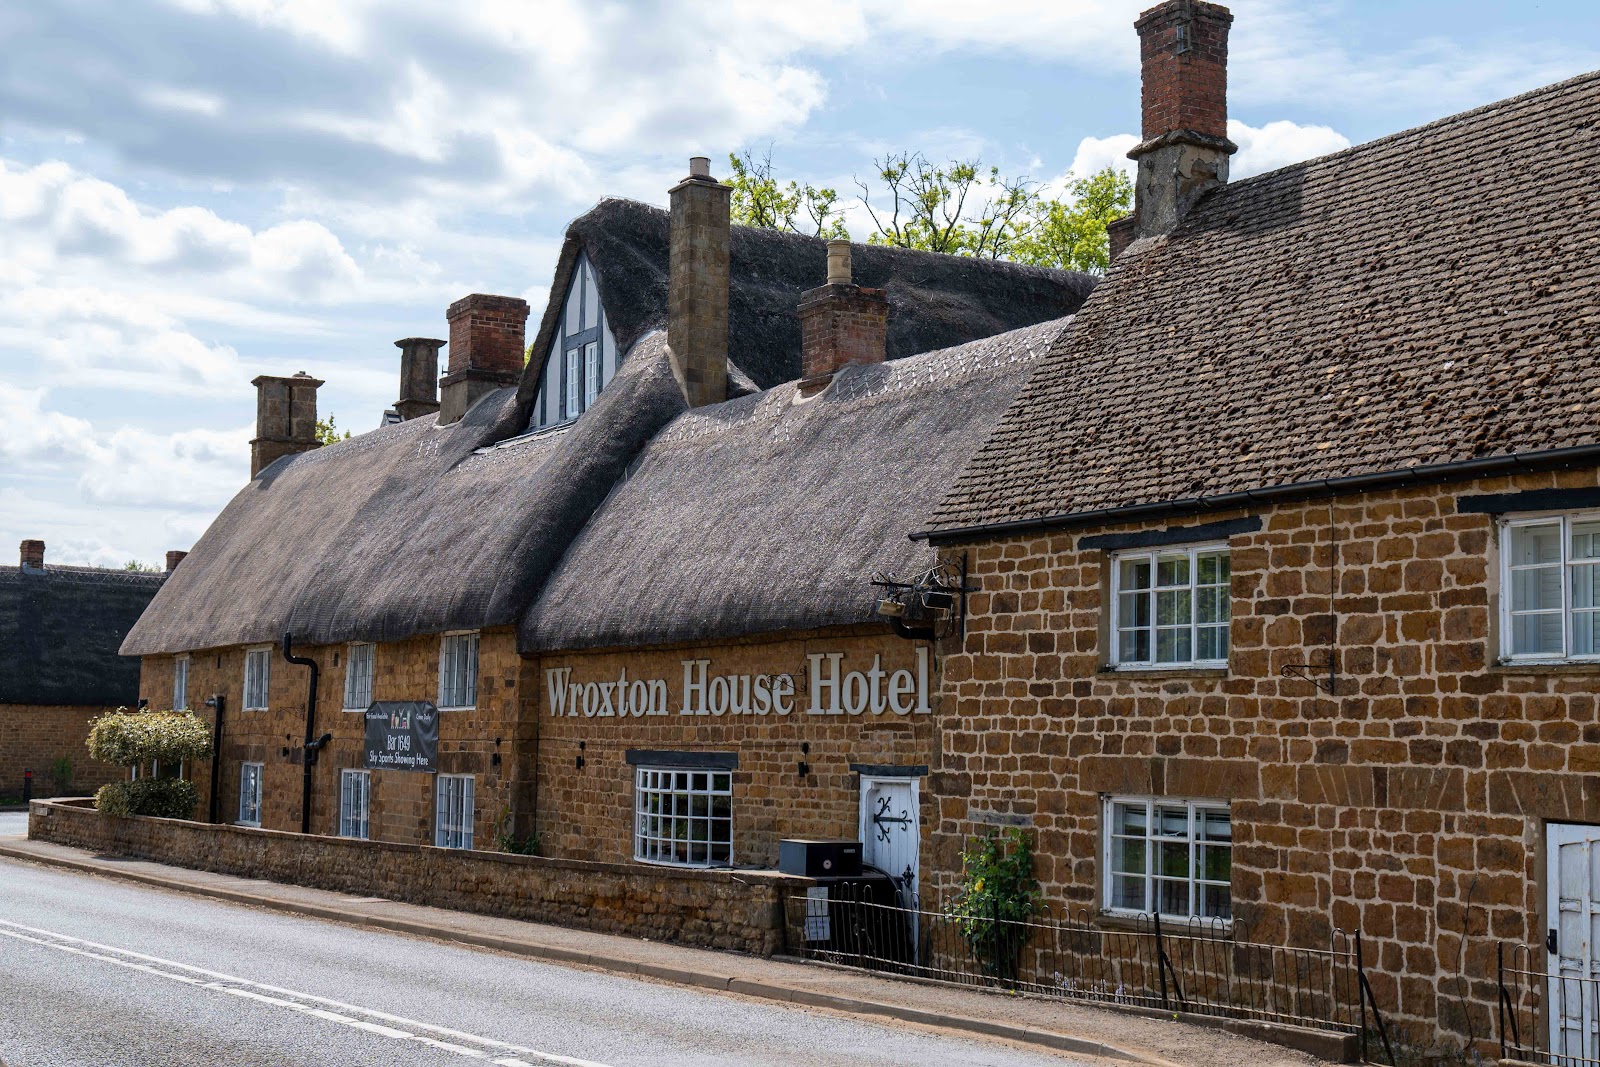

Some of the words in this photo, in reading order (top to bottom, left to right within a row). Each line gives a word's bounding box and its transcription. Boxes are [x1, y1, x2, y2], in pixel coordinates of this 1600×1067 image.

[546, 667, 669, 717] Wroxton
[680, 659, 795, 716] House
[806, 647, 932, 716] Hotel
[387, 735, 397, 750] Bar
[398, 735, 410, 751] 1649
[369, 750, 378, 764] Sky
[379, 751, 394, 766] Sports
[394, 752, 415, 767] Showing
[416, 753, 429, 766] Here
